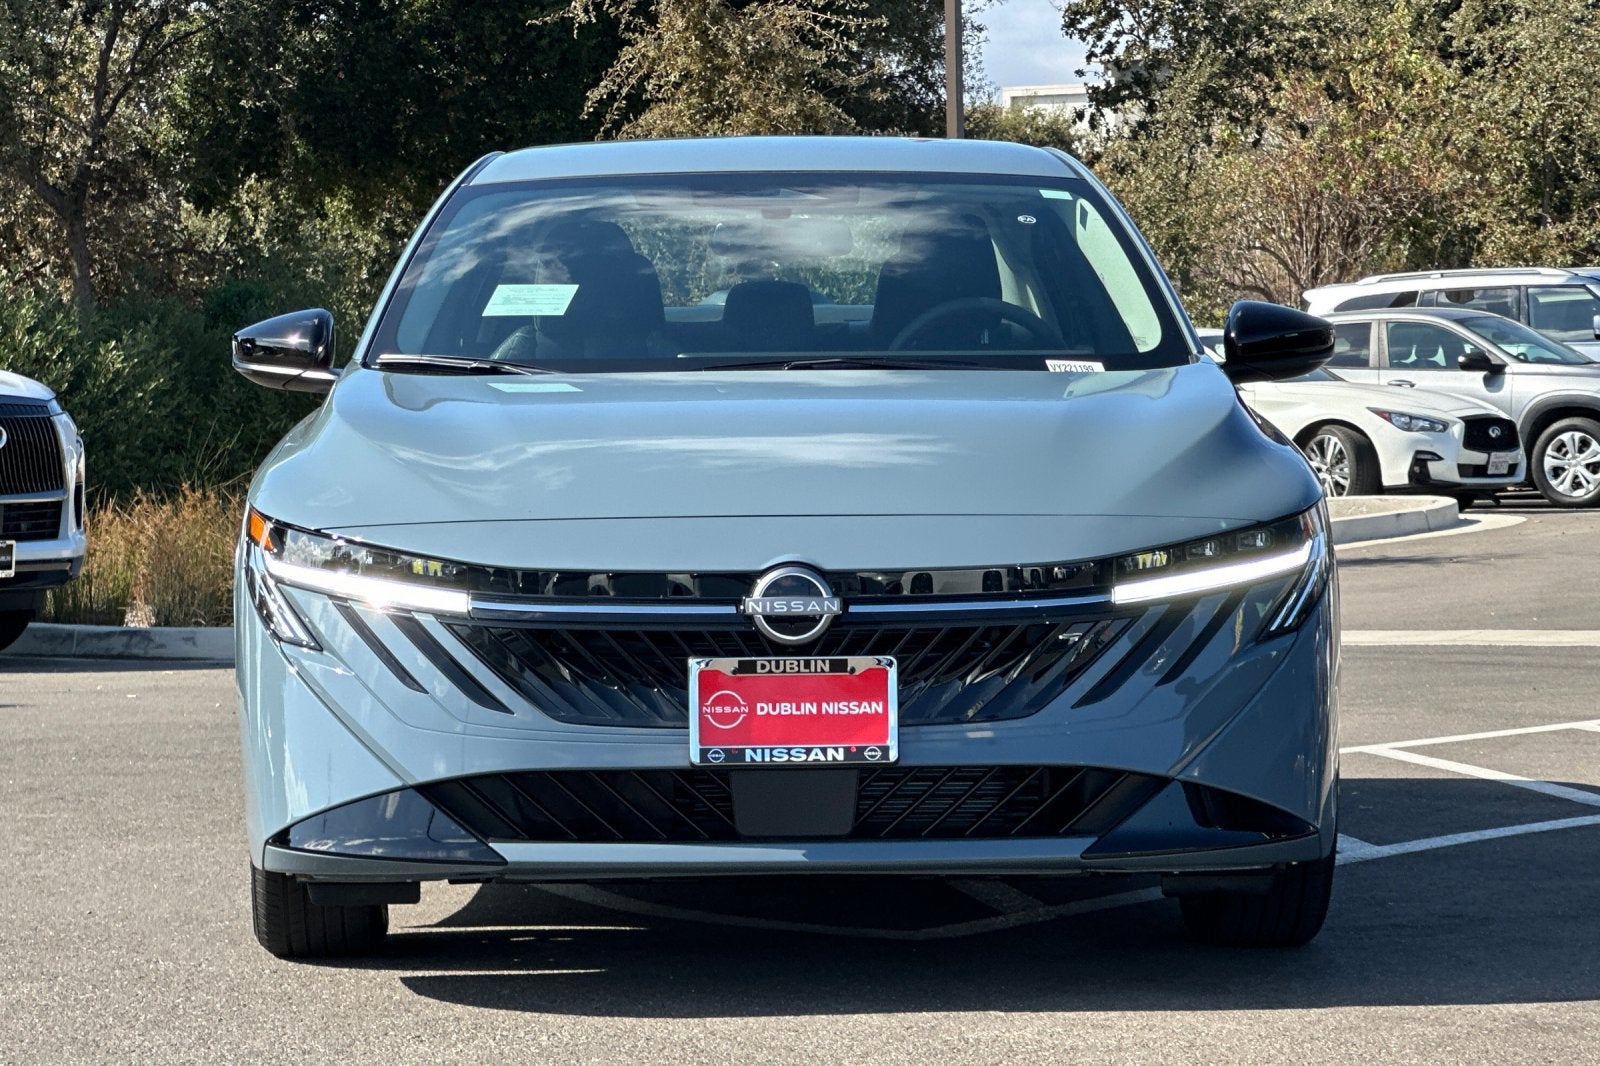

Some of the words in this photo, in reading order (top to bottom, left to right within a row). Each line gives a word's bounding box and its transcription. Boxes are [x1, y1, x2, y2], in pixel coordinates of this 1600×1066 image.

[748, 600, 838, 613] NISSAN
[756, 659, 830, 673] DUBLIN
[702, 706, 749, 714] NISSAN
[756, 702, 817, 716] DUBLIN
[821, 701, 883, 715] NISSAN
[745, 748, 844, 762] NISSAN
